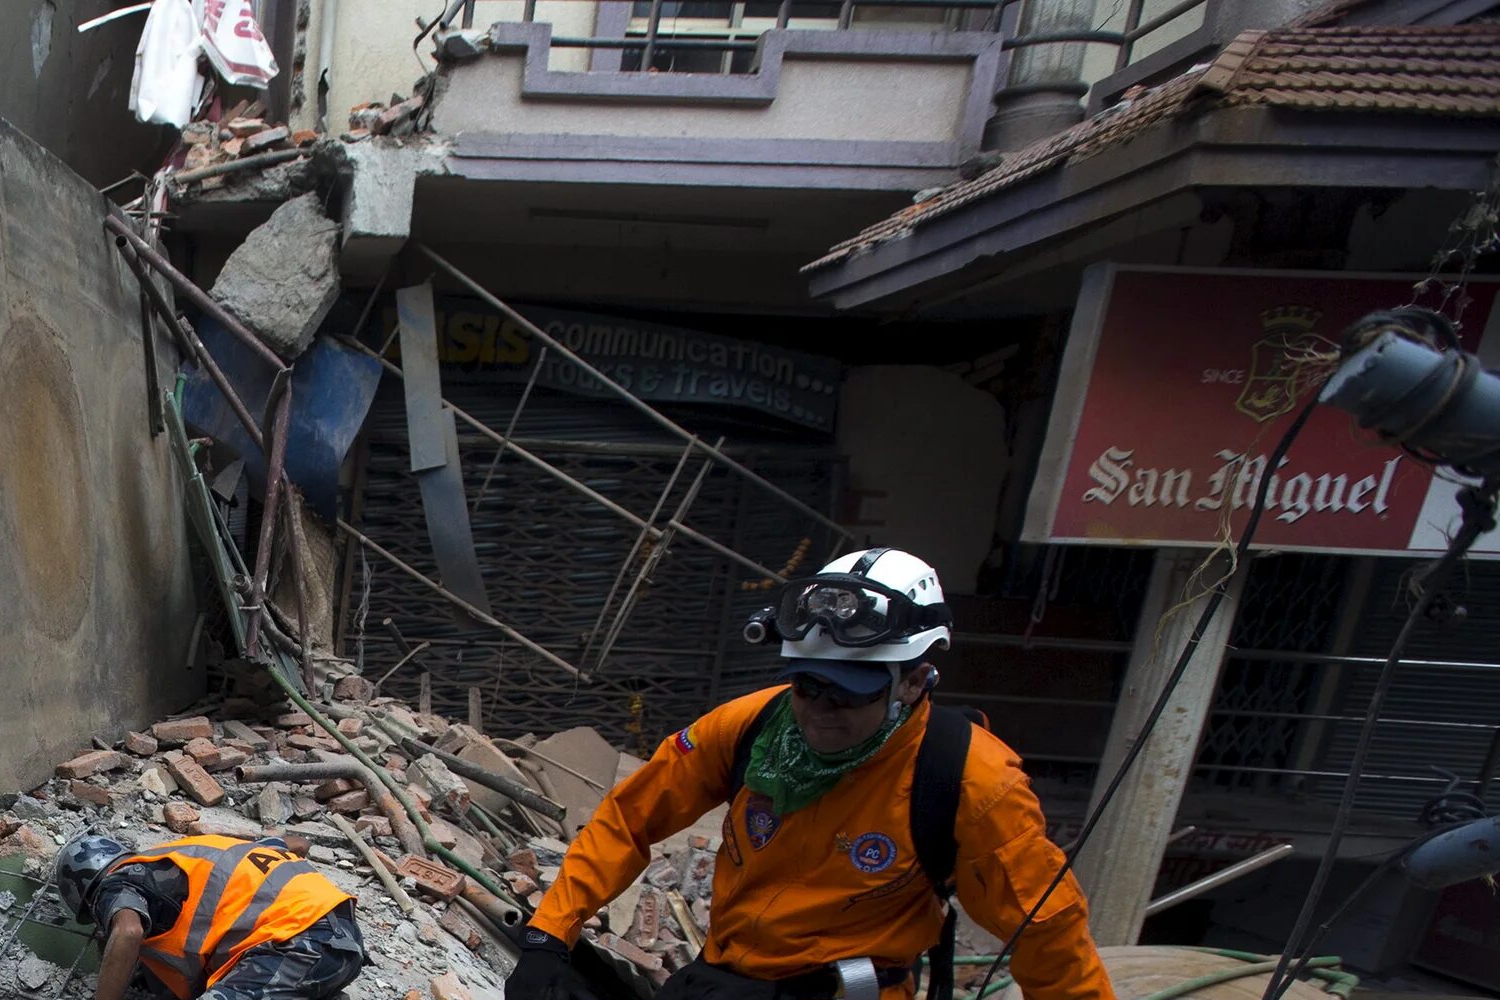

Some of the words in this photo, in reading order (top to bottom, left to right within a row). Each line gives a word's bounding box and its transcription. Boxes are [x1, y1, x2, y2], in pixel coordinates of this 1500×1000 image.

[1200, 367, 1246, 385] SINCE
[1083, 445, 1192, 508] San
[1195, 447, 1405, 524] Miguel
